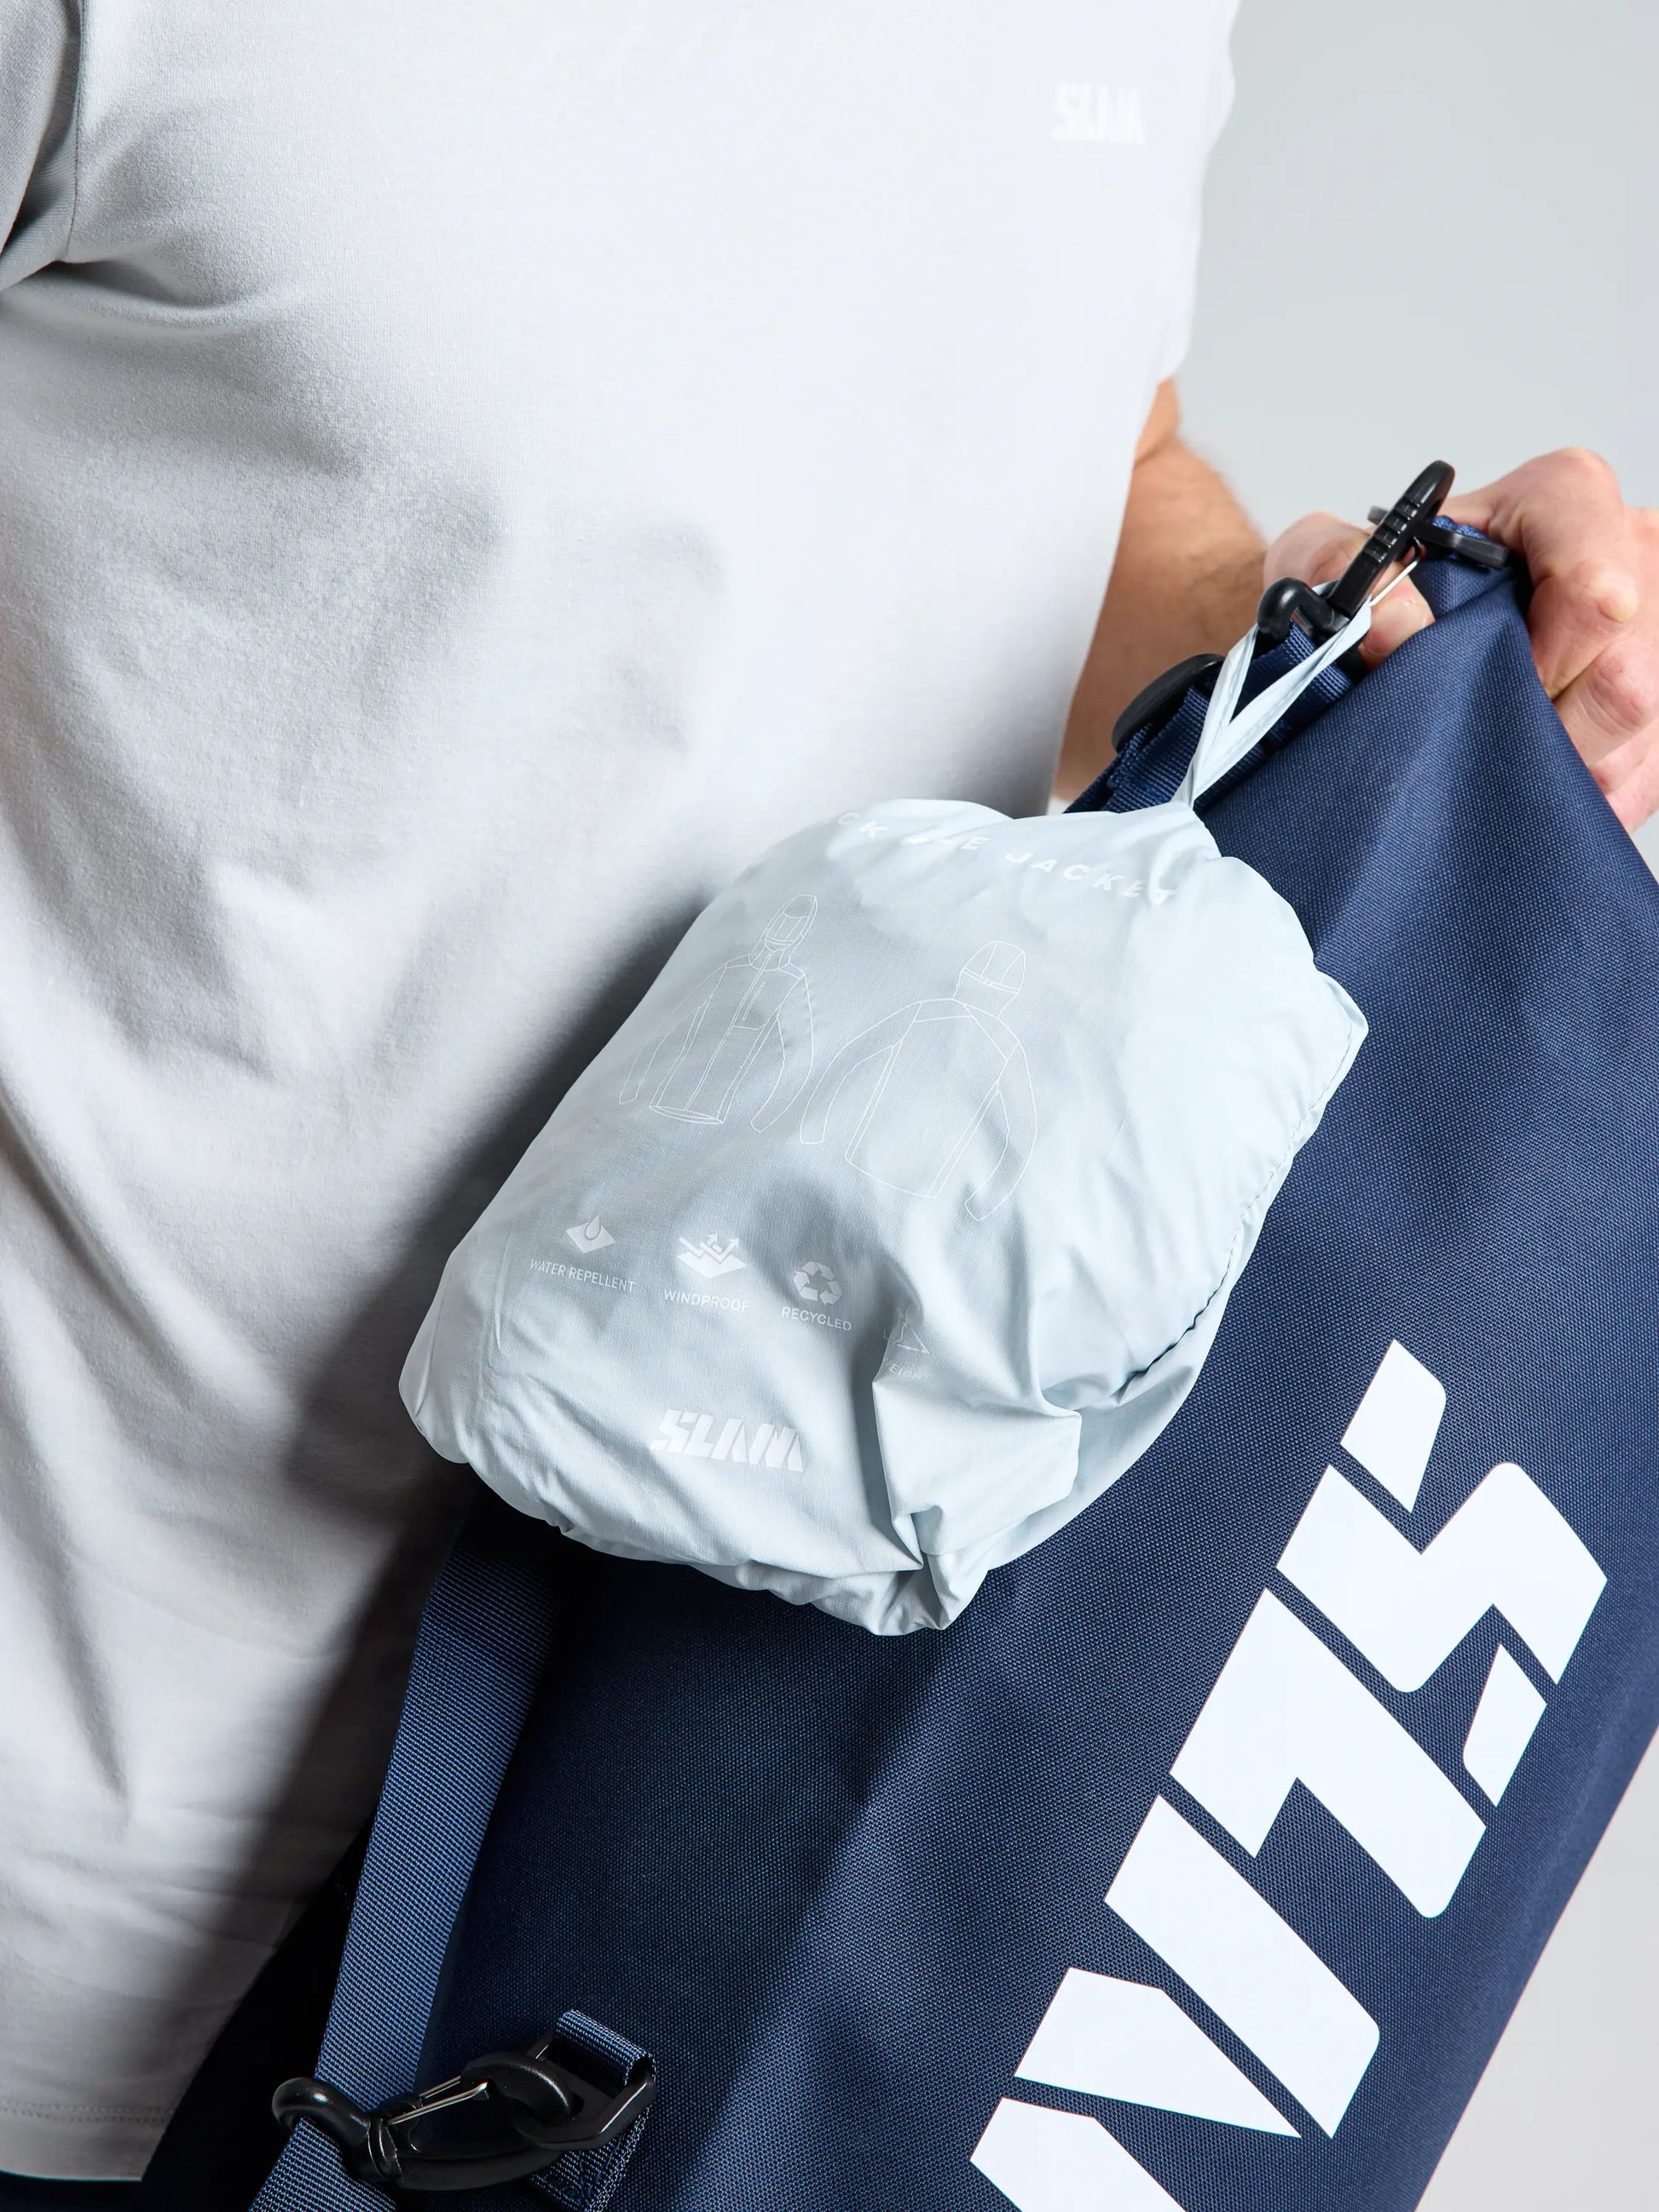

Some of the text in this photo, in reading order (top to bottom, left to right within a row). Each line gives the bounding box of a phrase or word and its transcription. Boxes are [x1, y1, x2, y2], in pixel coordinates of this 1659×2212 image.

[1052, 81, 1145, 147] SLAM
[529, 1259, 635, 1292] WATER REPELLENT
[663, 1288, 751, 1312] WINDPROOF
[780, 1306, 852, 1331] RECYCLED
[649, 1408, 803, 1472] SLAM
[969, 1339, 1607, 2212] SLA
